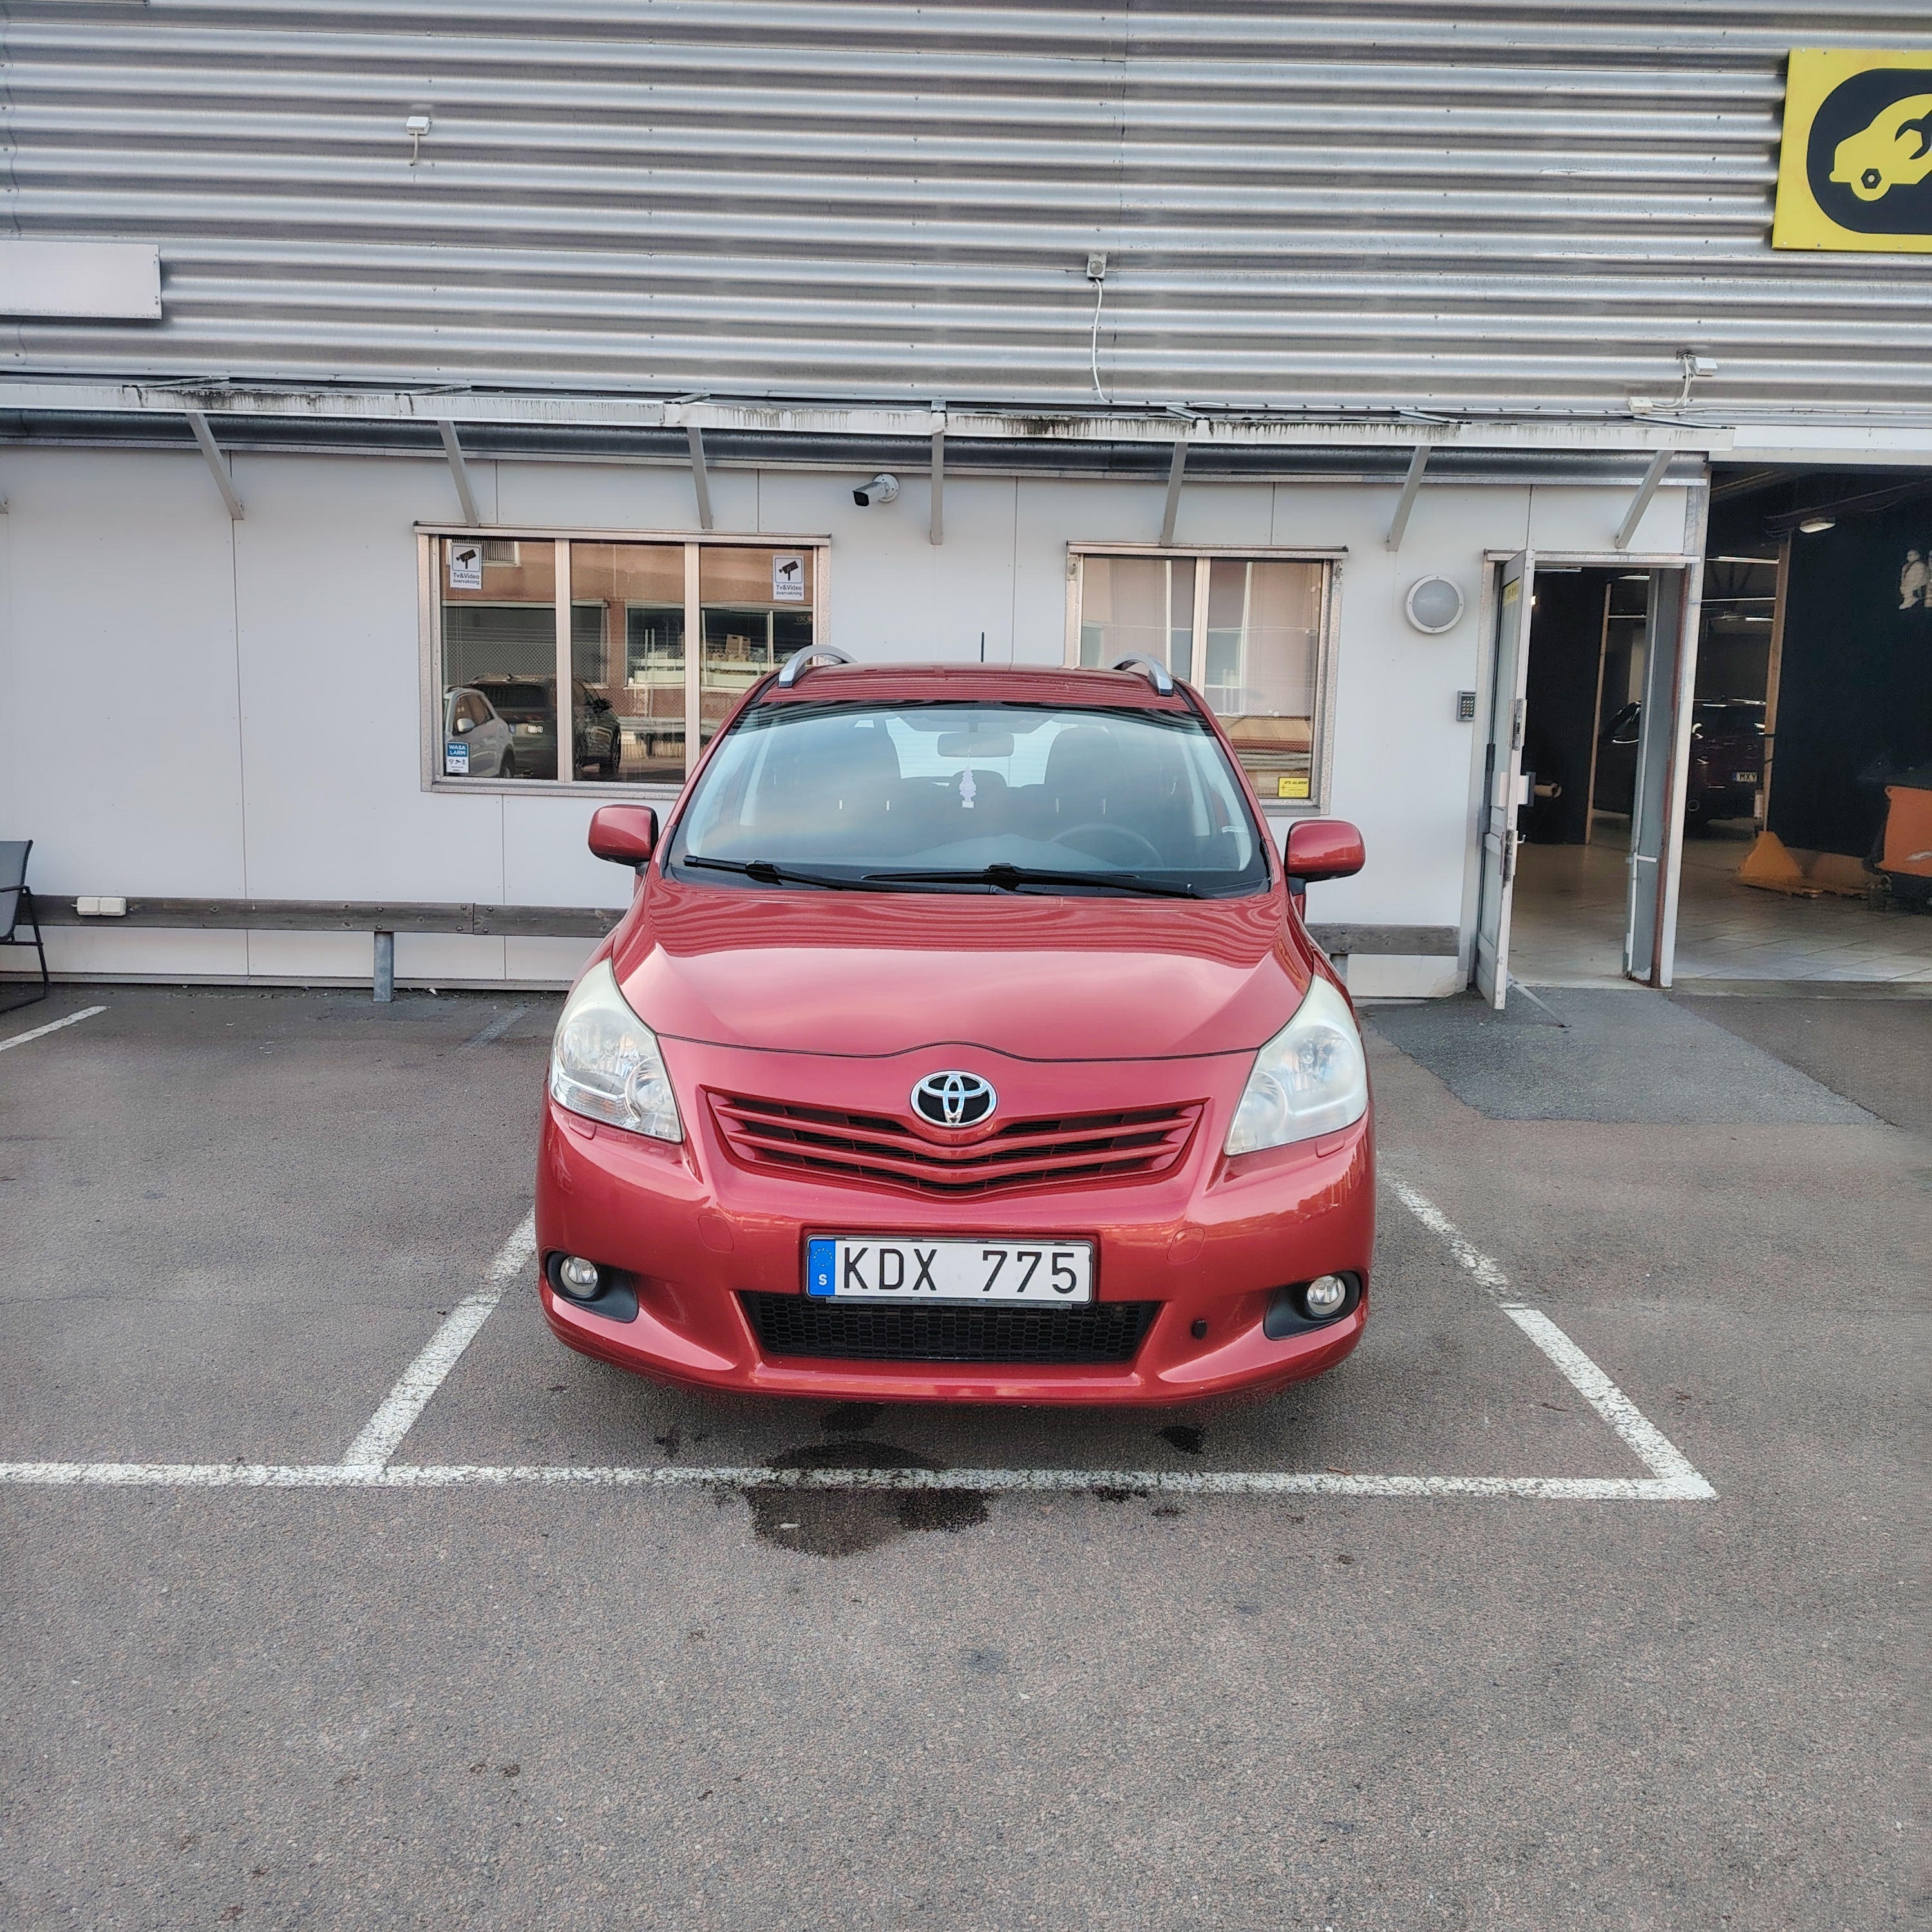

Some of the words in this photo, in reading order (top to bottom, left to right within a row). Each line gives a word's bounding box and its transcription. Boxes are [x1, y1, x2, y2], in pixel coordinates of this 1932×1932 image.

[819, 1273, 828, 1286] S
[844, 1247, 937, 1291] KDX
[982, 1250, 1077, 1294] 775
